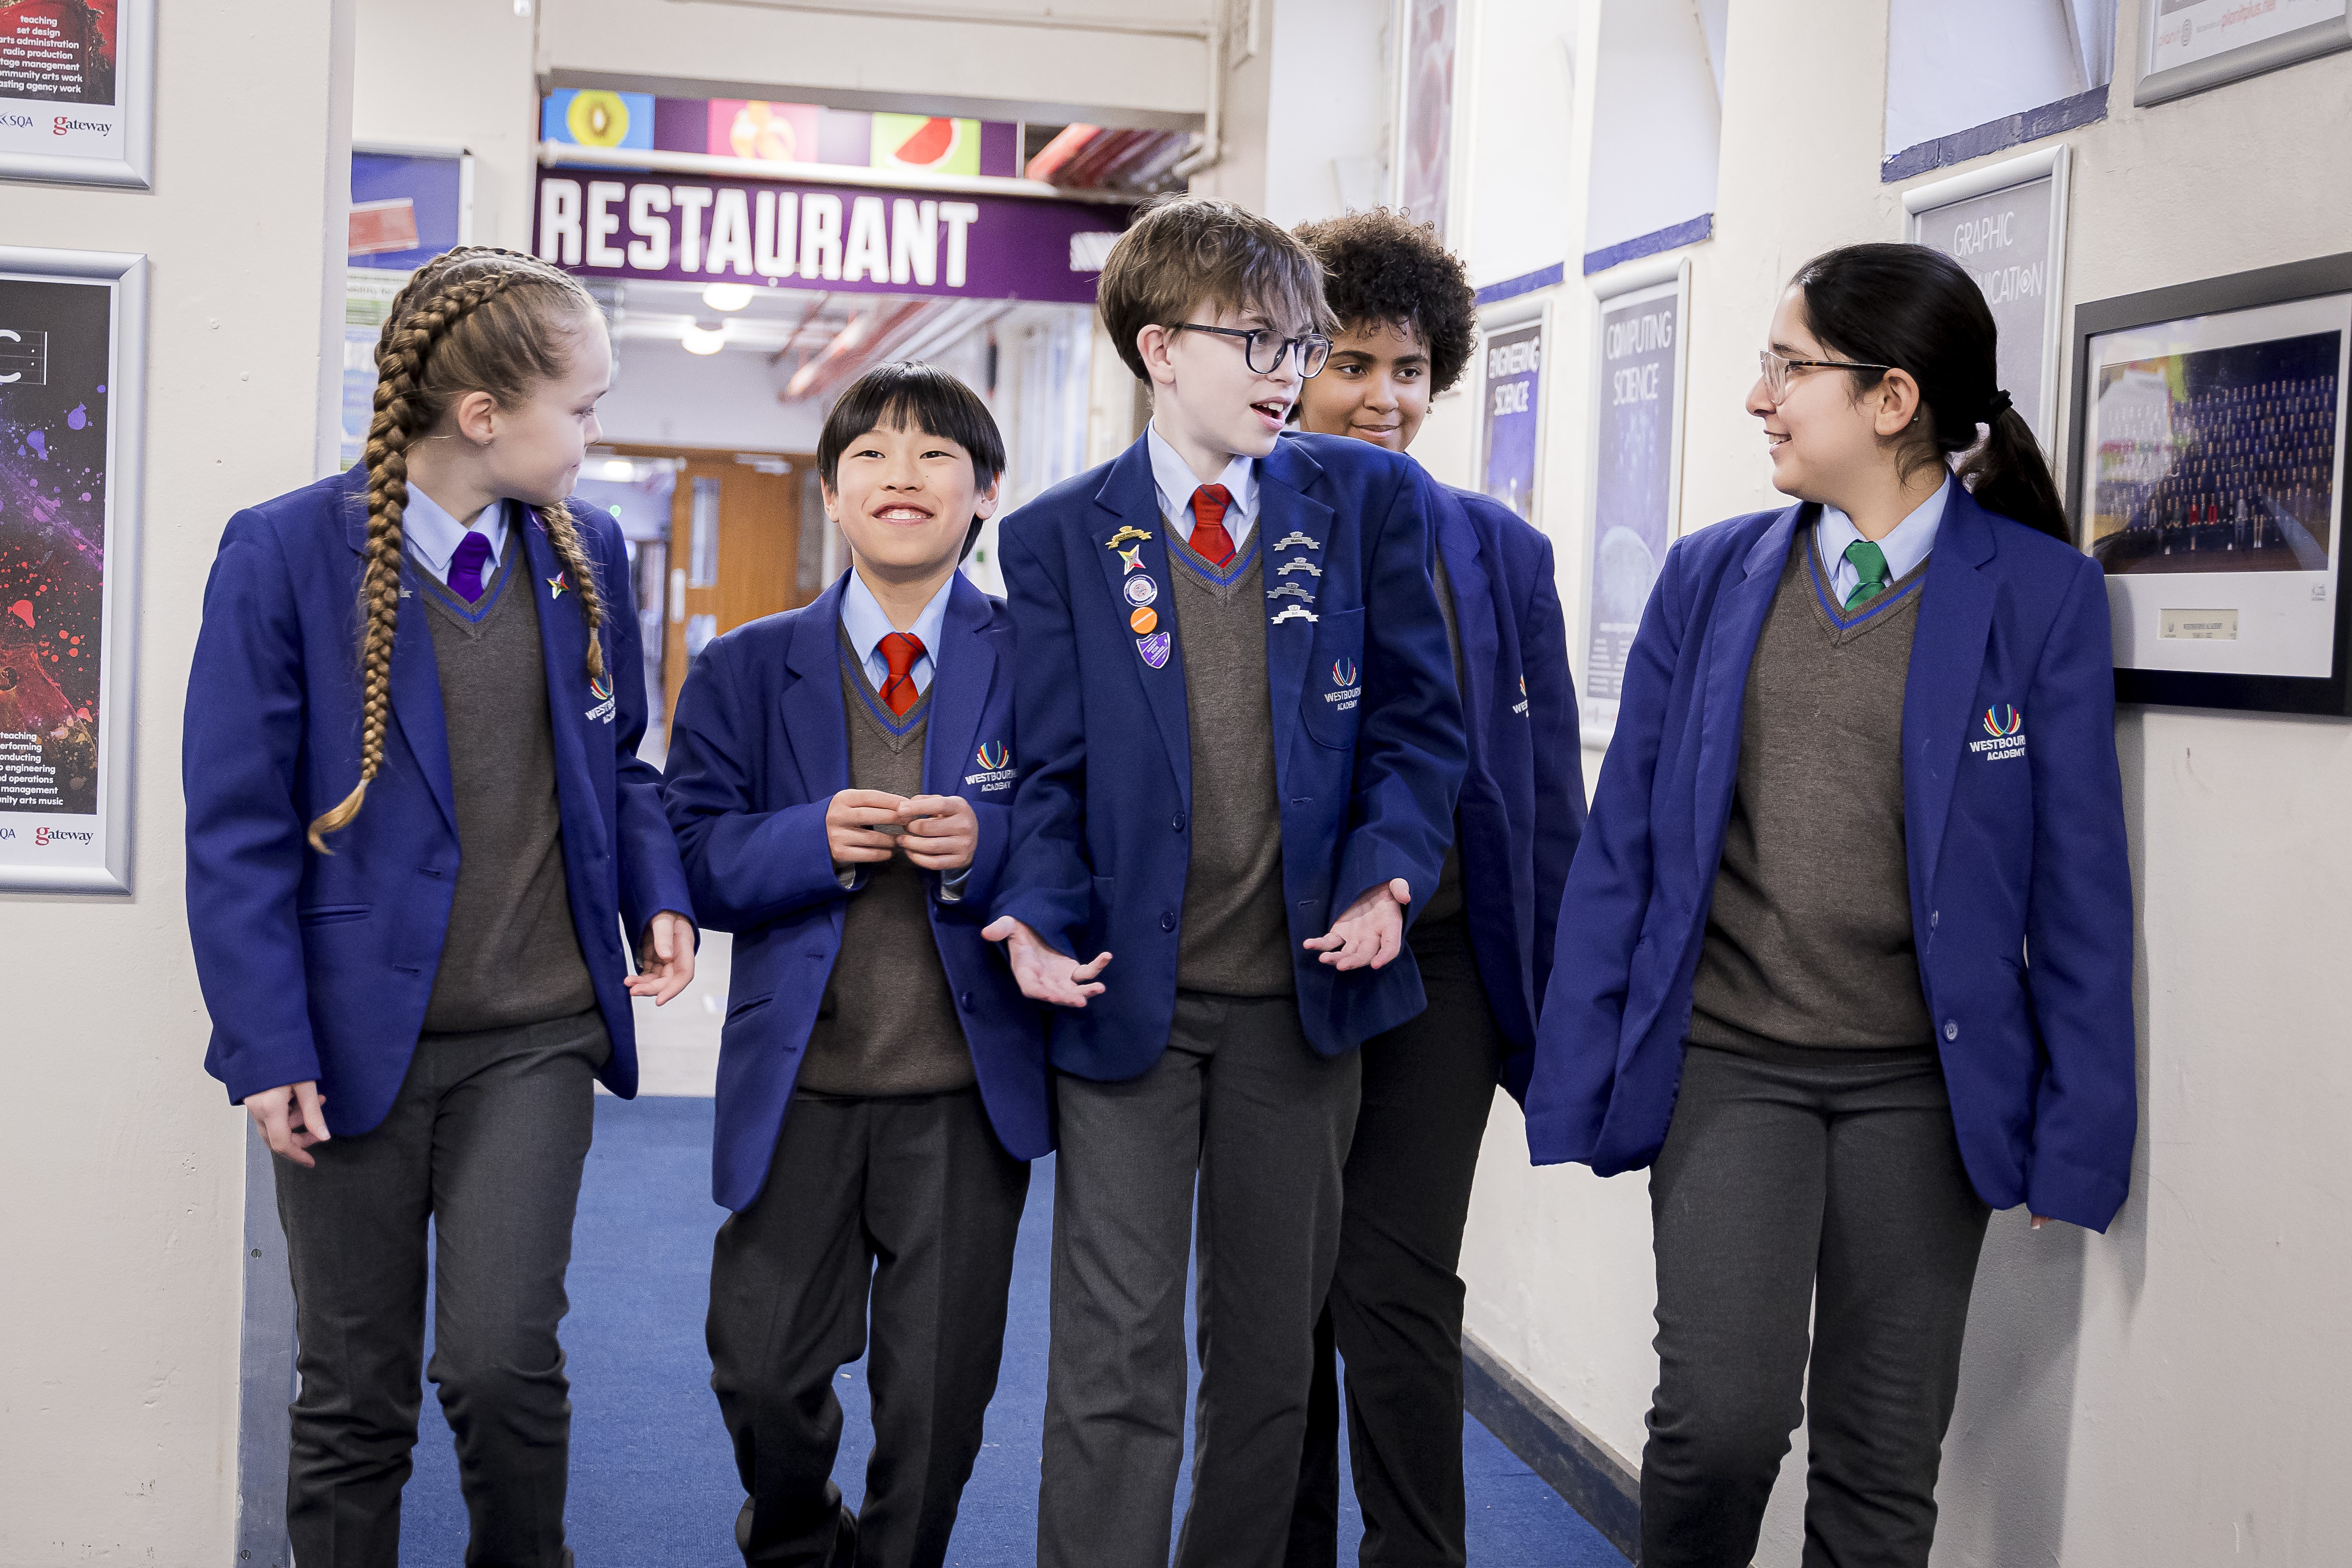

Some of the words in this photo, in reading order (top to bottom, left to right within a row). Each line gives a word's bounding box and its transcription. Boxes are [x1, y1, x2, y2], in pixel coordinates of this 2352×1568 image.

[20, 15, 58, 27] teaching
[32, 27, 60, 38] design
[16, 36, 79, 49] administration
[3, 47, 26, 56] radio
[27, 49, 73, 60] production
[22, 60, 80, 71] management
[61, 74, 83, 82] work
[26, 82, 58, 93] agency
[60, 84, 81, 93] work
[10, 115, 33, 128] SQA
[53, 116, 113, 137] gateway
[539, 178, 980, 287] RESTAURANT
[1954, 211, 2015, 257] GRAPHIC
[1606, 310, 1672, 360] COMPUTING
[1613, 363, 1660, 406] SCIENCE
[1147, 640, 1158, 653] AGENT
[1151, 645, 1166, 660] CHANGE
[1337, 700, 1358, 711] ACADEMY
[0, 731, 37, 742] teaching
[1969, 734, 2026, 752] WESTBOUR
[1987, 747, 2025, 761] ACADEMY
[5, 764, 56, 775] engineering
[9, 775, 54, 784] operations
[981, 780, 1011, 792] ACADEMY
[1, 786, 58, 795] management
[0, 795, 18, 806] nity
[38, 797, 63, 806] music
[35, 827, 94, 845] gateway
